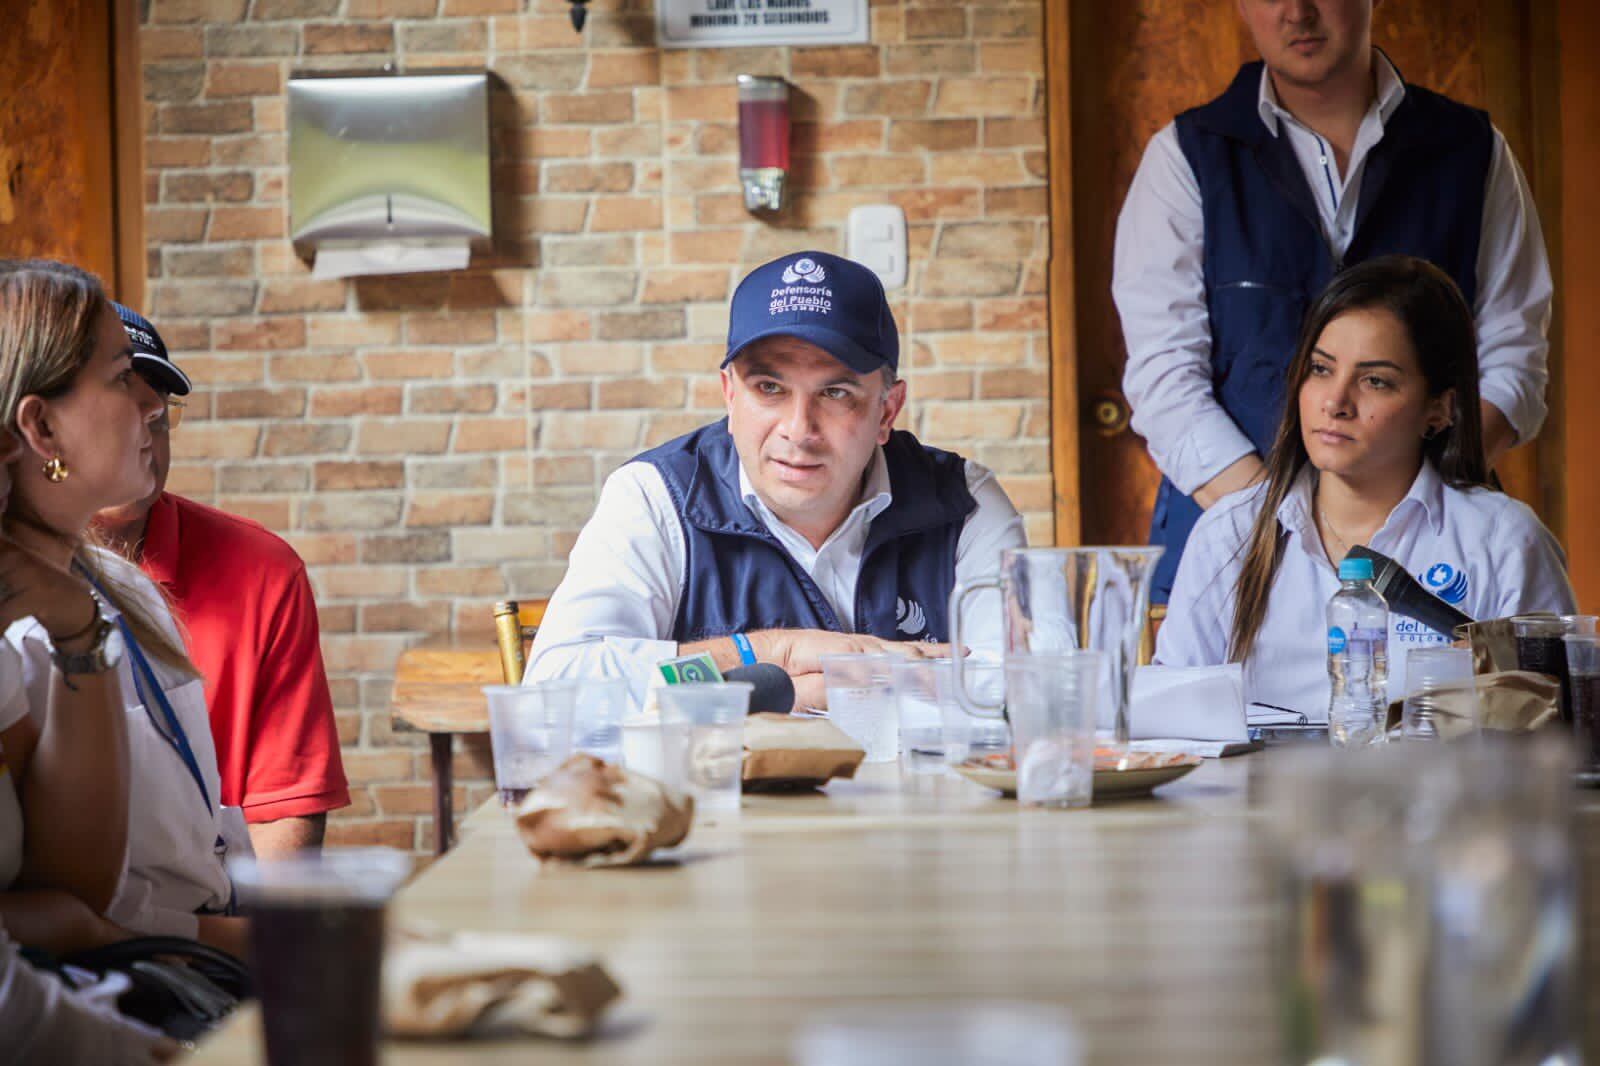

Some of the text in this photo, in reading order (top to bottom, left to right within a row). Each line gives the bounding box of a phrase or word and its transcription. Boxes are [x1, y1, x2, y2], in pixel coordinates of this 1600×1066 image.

[763, 11, 829, 25] SEGUNDOS
[771, 286, 832, 298] Defensoría
[770, 295, 832, 308] del Pueblo
[770, 305, 828, 315] COLOMBIA
[1396, 620, 1419, 632] del
